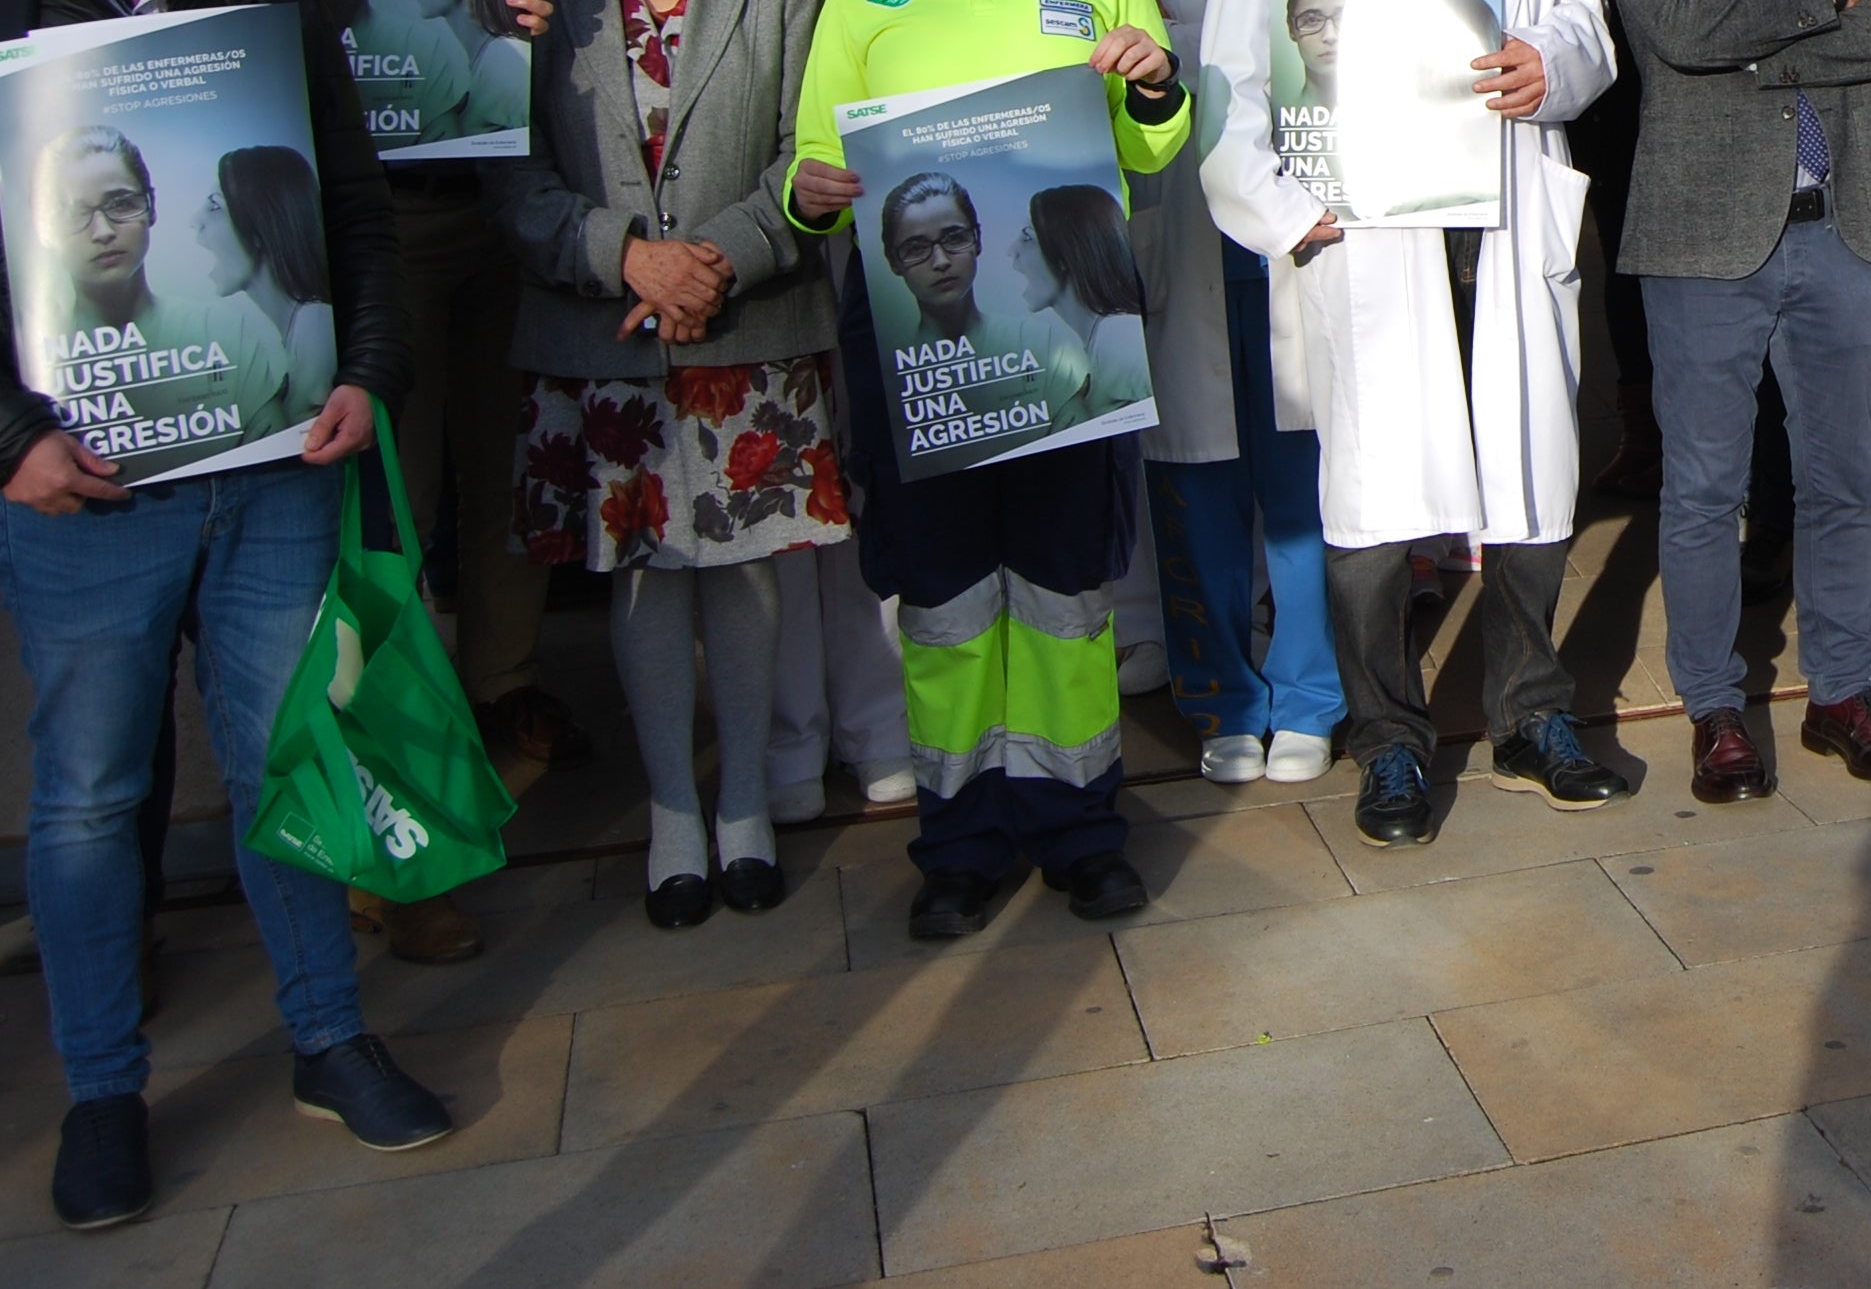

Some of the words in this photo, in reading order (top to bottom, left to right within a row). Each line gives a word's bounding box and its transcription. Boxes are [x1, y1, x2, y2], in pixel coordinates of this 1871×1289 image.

[847, 104, 887, 119] SATSE
[912, 133, 934, 145] HAN
[934, 125, 976, 141] SUFRIDO
[977, 121, 998, 133] UNA
[1000, 112, 1047, 129] AGRESIÓN
[951, 117, 969, 128] LAS
[971, 103, 1051, 125] ENFERMERAS/OS
[982, 127, 1019, 141] VERBAL
[40, 321, 146, 363] NADA
[894, 335, 975, 370] NADA
[50, 340, 229, 396] JUSTIFICA
[902, 348, 1039, 397] JUSTIFICA
[51, 390, 134, 428] UNA
[903, 391, 967, 423] UNA
[83, 402, 242, 459] GRESIÓN
[911, 400, 1050, 452] AGRESIÓN
